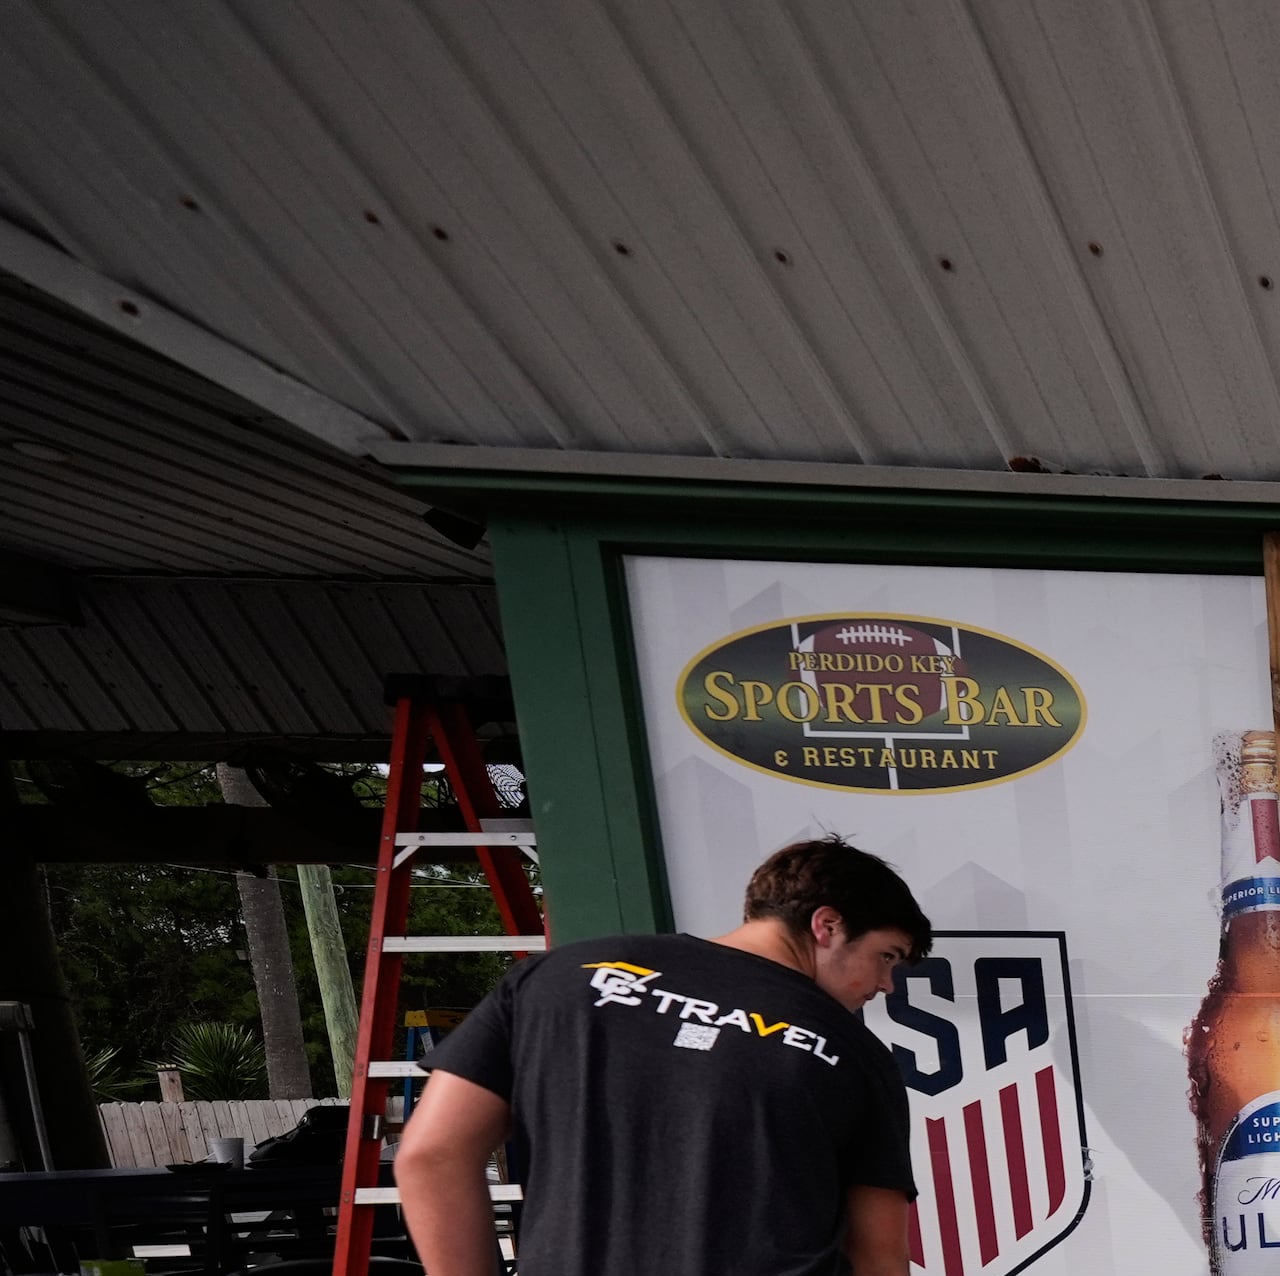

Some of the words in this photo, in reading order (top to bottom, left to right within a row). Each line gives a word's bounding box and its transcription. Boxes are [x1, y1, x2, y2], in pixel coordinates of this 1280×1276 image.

[788, 652, 904, 674] PERDIDO
[910, 655, 958, 675] KEY
[803, 747, 999, 770] RESTAURANT
[651, 988, 840, 1067] TRAVEL
[858, 957, 1049, 1096] SA
